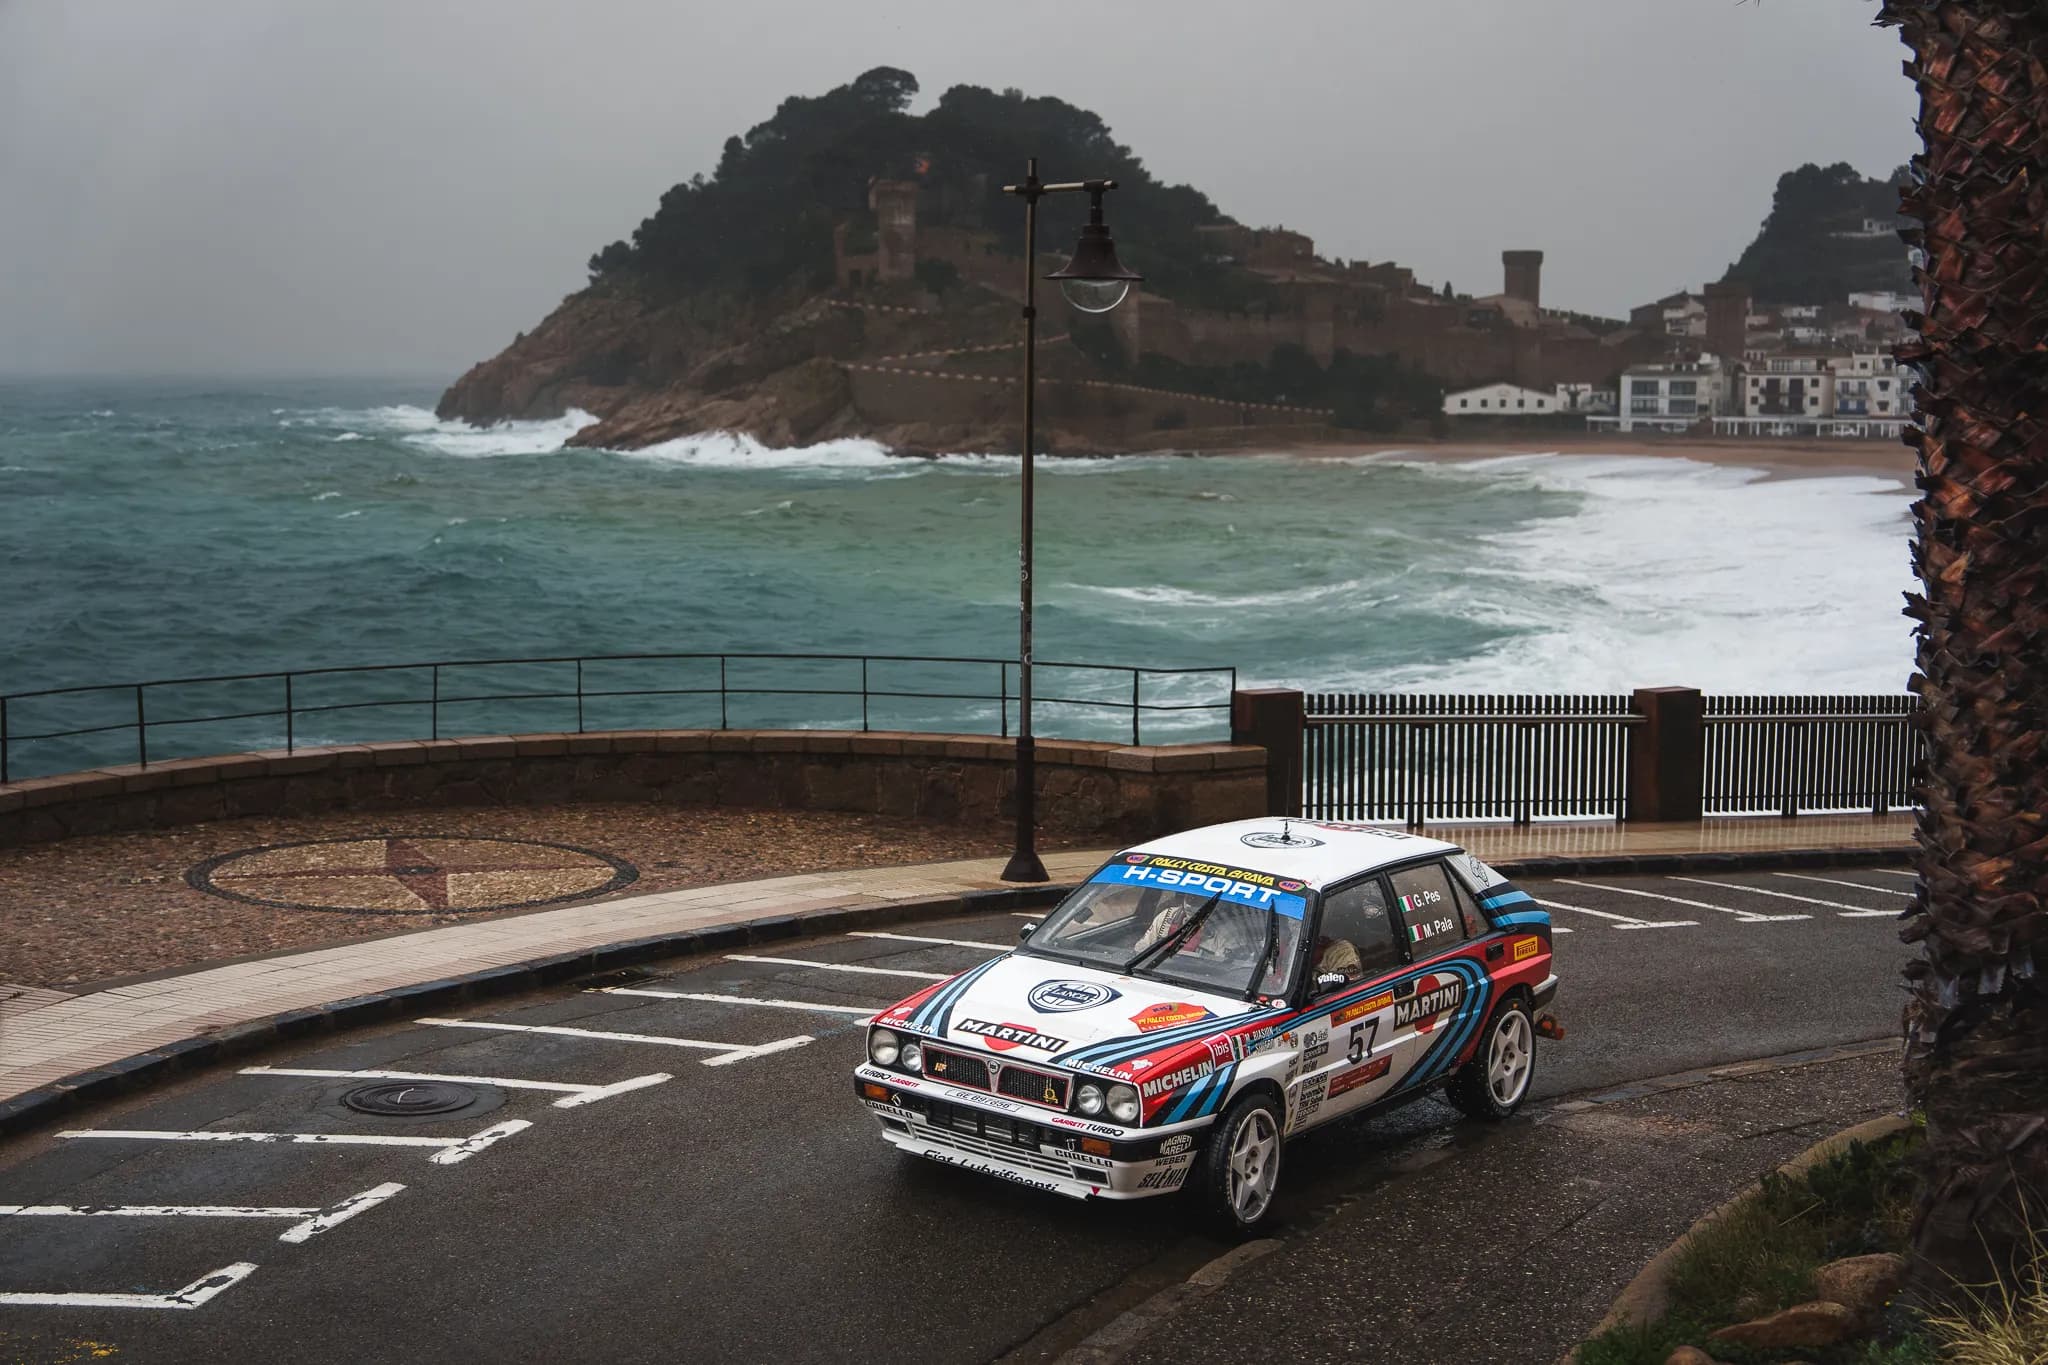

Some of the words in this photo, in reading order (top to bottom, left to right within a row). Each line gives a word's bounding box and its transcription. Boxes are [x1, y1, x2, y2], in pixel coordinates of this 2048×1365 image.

[1149, 857, 1188, 869] RALLY
[1187, 863, 1226, 876] COSTA
[1228, 870, 1275, 886] BRAVA
[1123, 866, 1282, 903] H-SPORT
[1413, 893, 1424, 907] G.
[1423, 890, 1441, 905] Pes
[1423, 924, 1435, 938] M.
[1435, 917, 1453, 934] Pala
[1516, 940, 1536, 957] PIRELLI
[1317, 972, 1345, 984] valeo
[1396, 984, 1460, 1026] MARTINI
[880, 1017, 937, 1035] MICHELIN
[960, 1020, 1066, 1052] MARTINI
[1213, 1041, 1230, 1057] ibis
[1347, 1016, 1379, 1065] 57
[859, 1068, 891, 1081] TURBO
[889, 1077, 920, 1089] GARRETT
[1064, 1058, 1133, 1081] MICHELIN
[1142, 1060, 1213, 1097] MICHELIN
[1051, 1117, 1086, 1129] GARRETT
[1086, 1123, 1125, 1137] TURBO
[923, 1149, 953, 1164] Fiat
[960, 1158, 1060, 1192] Lubrificanti
[1155, 1155, 1187, 1167] WEBER
